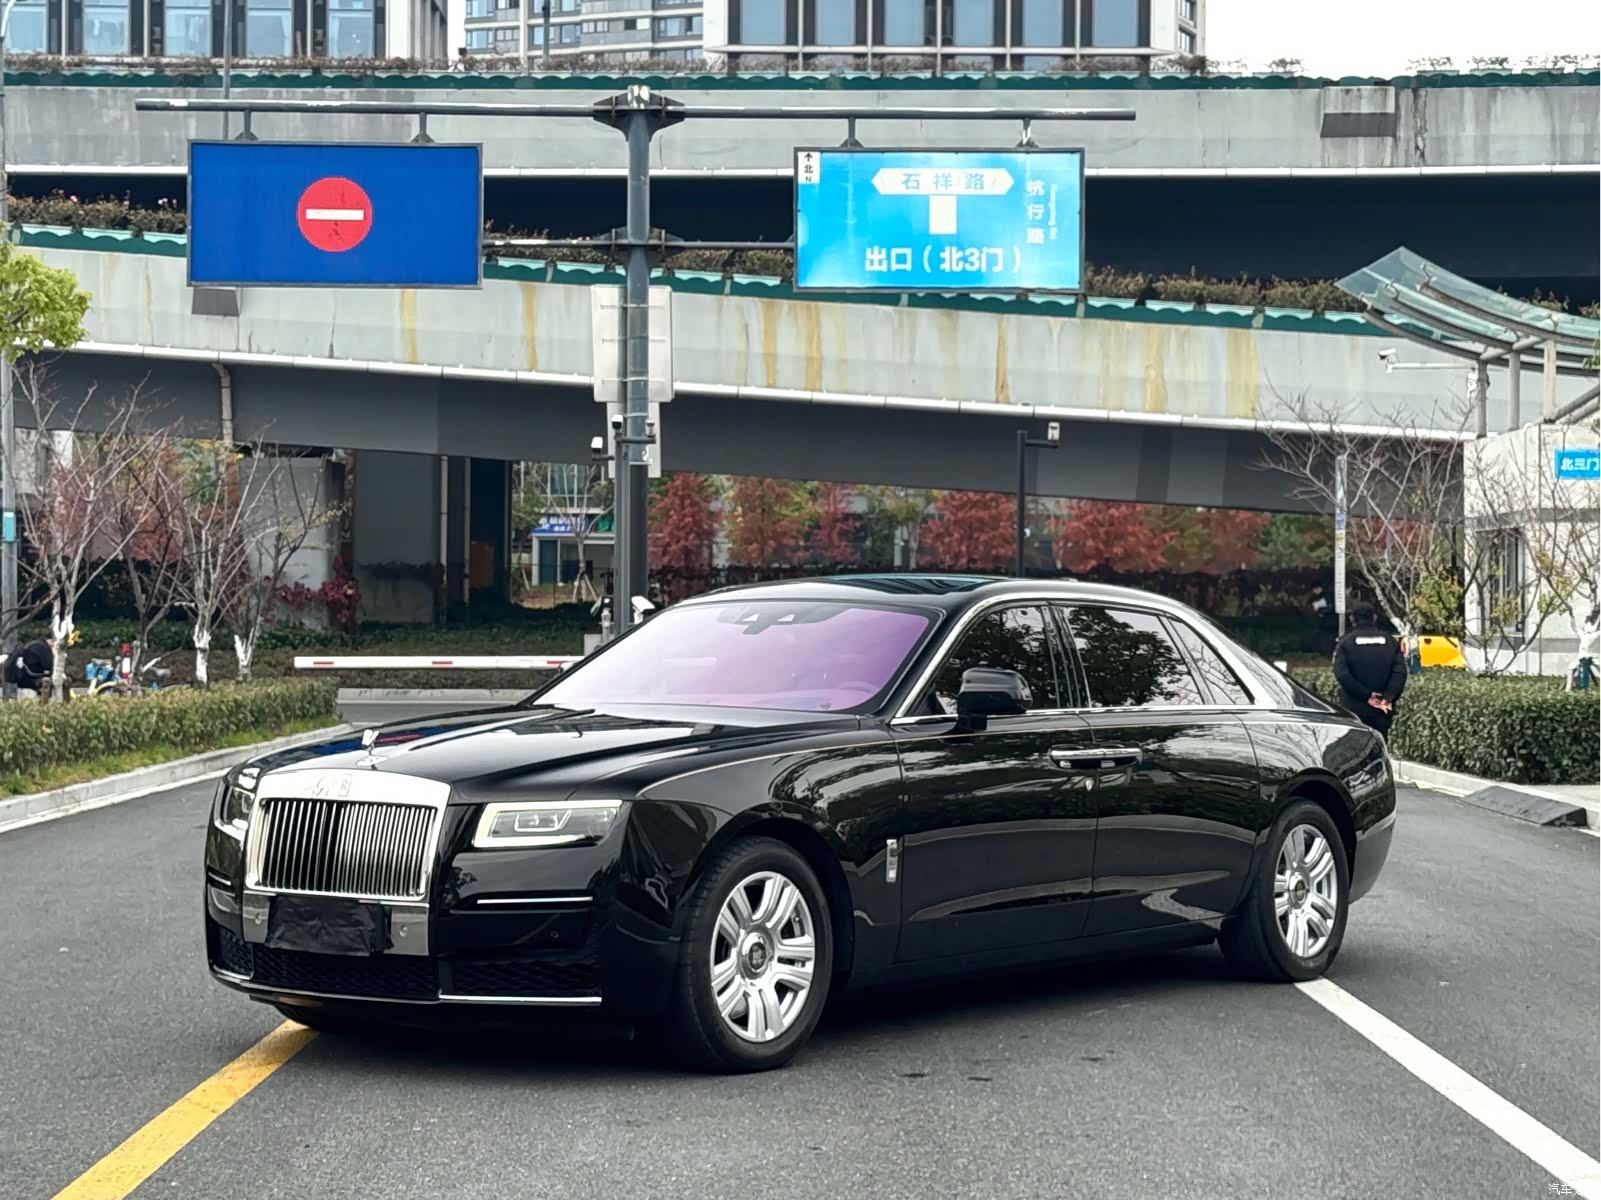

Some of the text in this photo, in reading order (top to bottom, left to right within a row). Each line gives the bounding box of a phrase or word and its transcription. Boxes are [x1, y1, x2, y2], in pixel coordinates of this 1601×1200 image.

[804, 164, 814, 174] 北
[901, 172, 985, 190] 石祥路
[1561, 457, 1599, 471] 北三门
